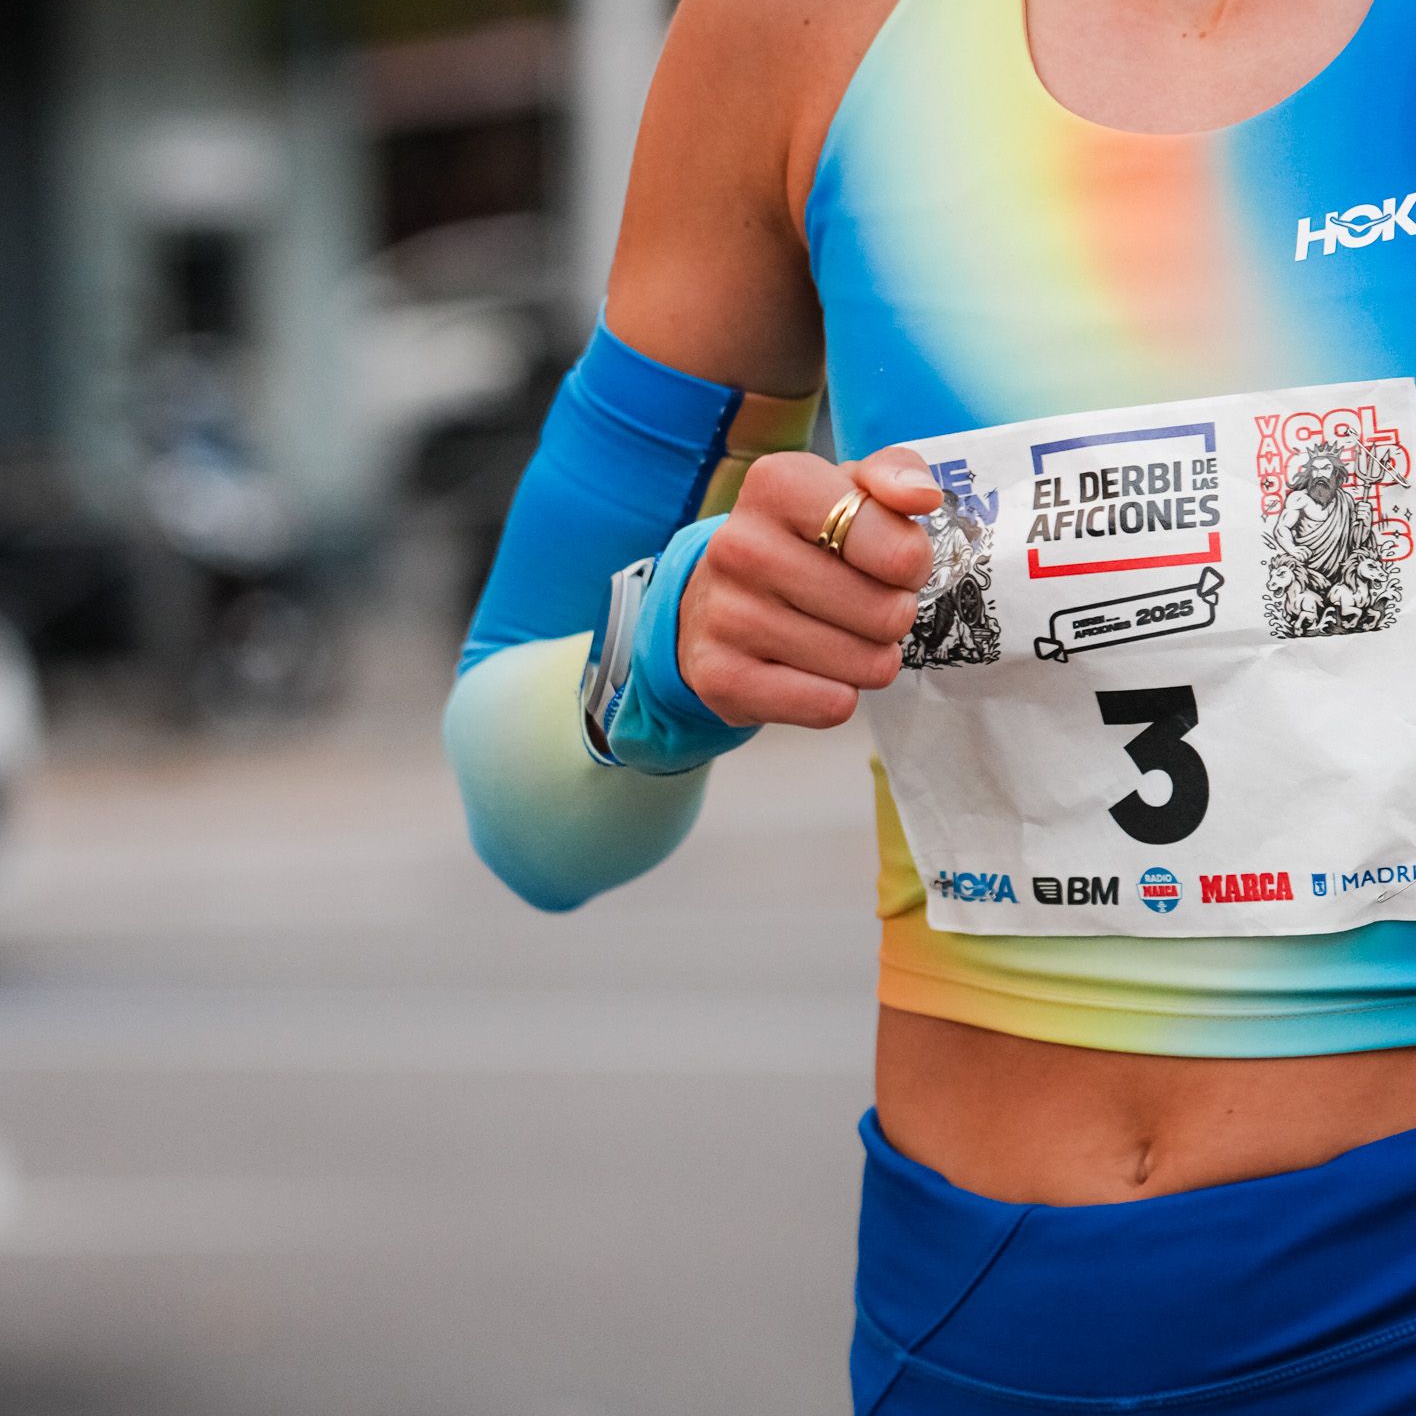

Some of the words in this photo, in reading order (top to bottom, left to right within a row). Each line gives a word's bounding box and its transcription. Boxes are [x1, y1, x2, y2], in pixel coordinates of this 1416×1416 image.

[1192, 457, 1218, 476] DE
[1254, 414, 1284, 515] VAMOS
[1033, 477, 1070, 510] EL
[1079, 461, 1182, 503] DERBI
[1192, 476, 1219, 491] LAS
[1026, 494, 1221, 544] AFICIONES
[1136, 599, 1194, 626] 2025
[1095, 684, 1210, 845] 3
[938, 871, 1020, 904] HOKA
[1067, 876, 1120, 905] BM
[1143, 885, 1178, 898] MARCA
[1144, 874, 1173, 883] RADIO
[1200, 872, 1295, 903] MARCA
